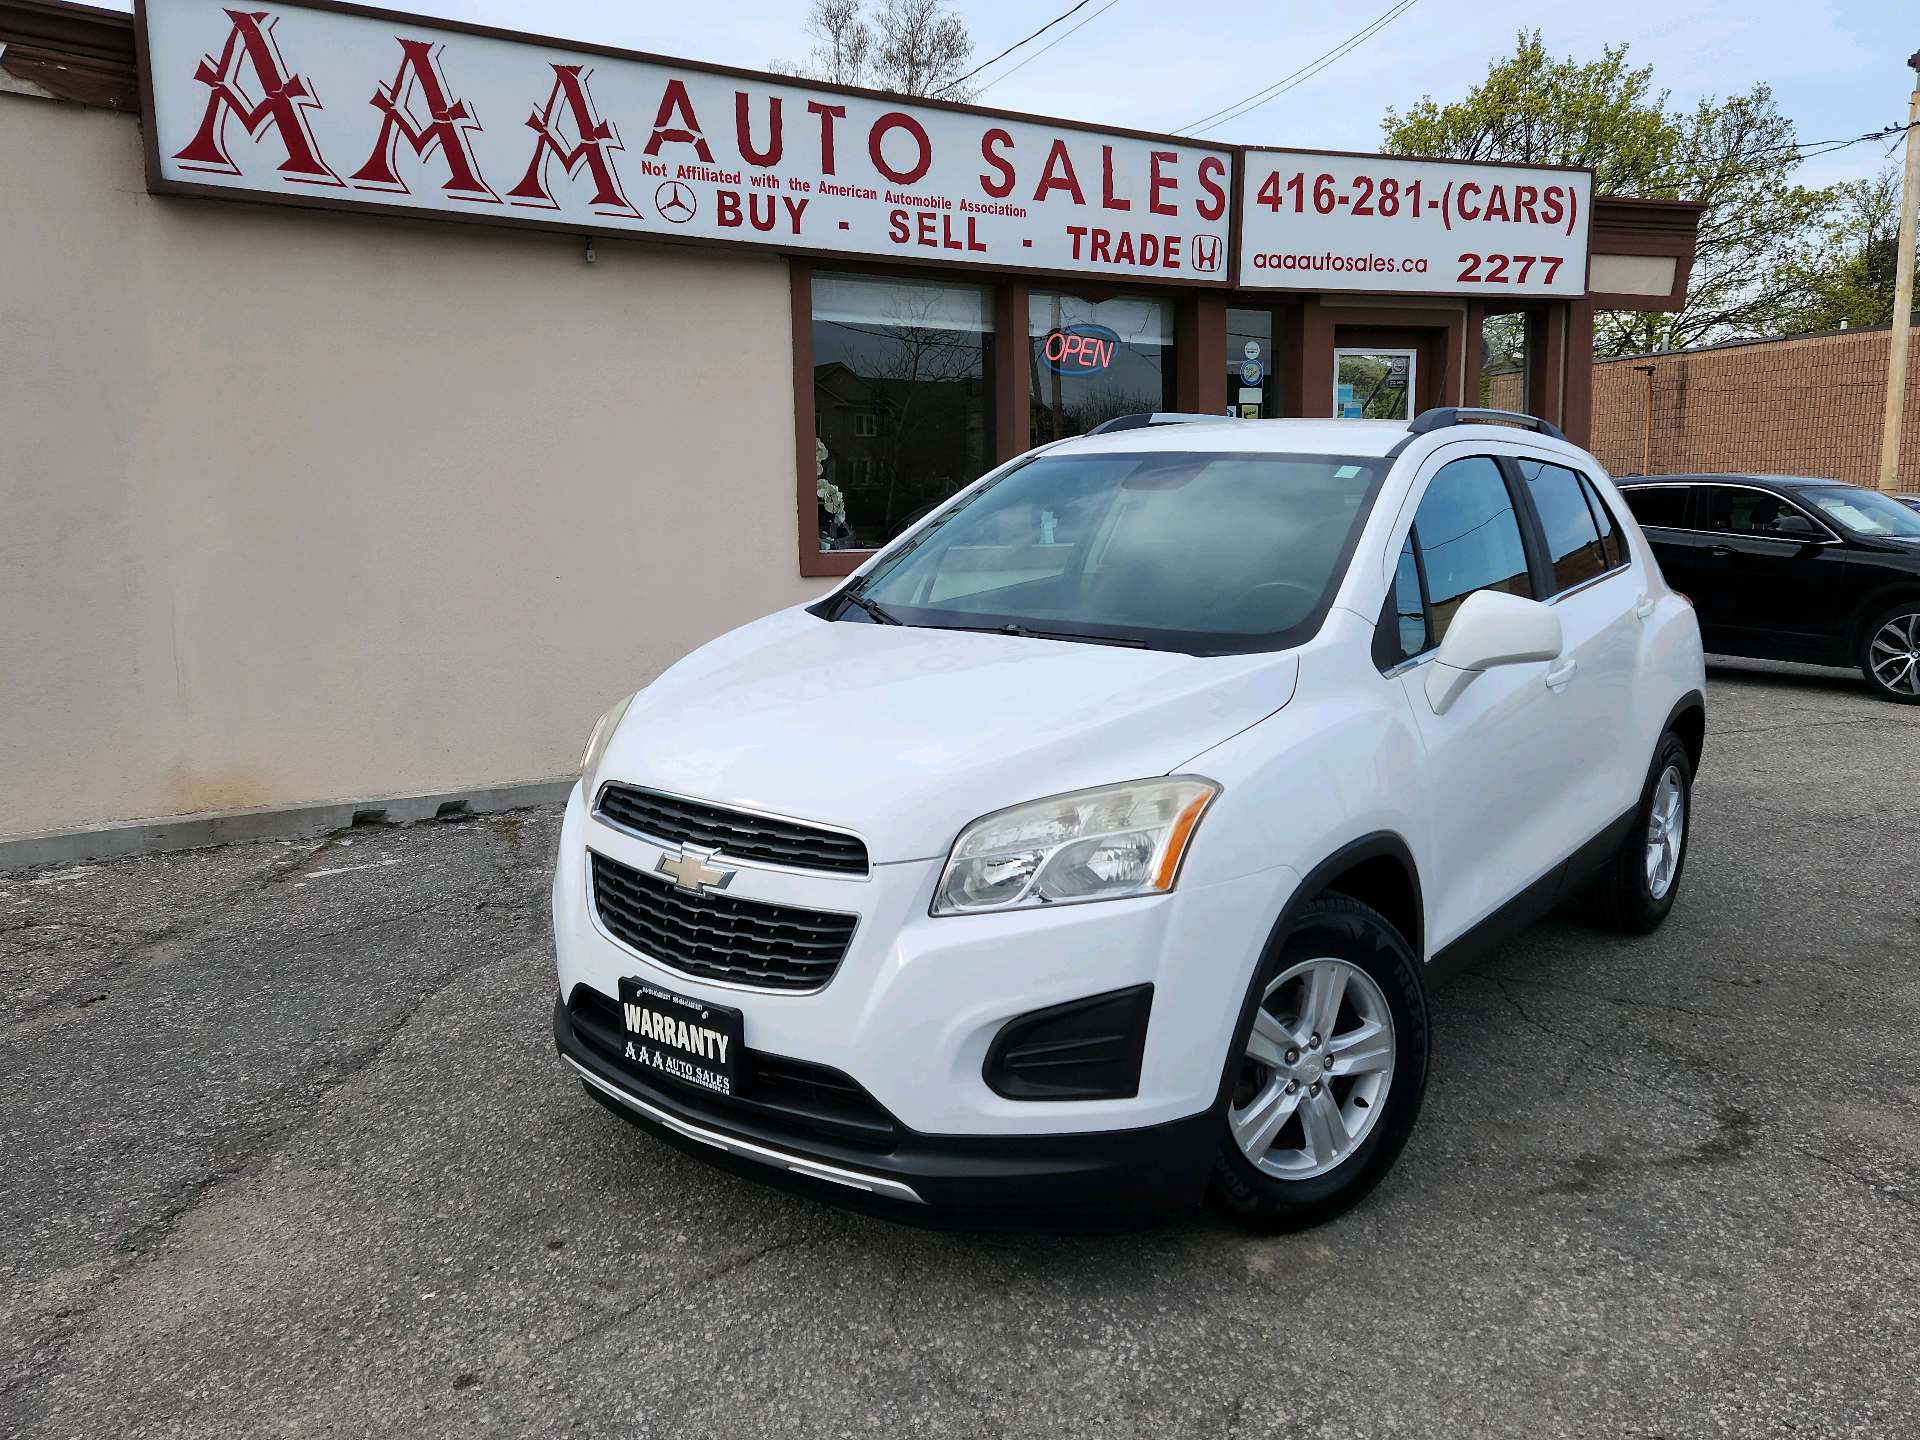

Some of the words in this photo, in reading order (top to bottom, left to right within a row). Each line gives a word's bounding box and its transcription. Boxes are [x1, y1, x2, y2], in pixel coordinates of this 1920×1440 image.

[643, 78, 932, 185] AUTO
[979, 128, 1226, 221] SALES
[641, 160, 667, 177] Not
[676, 164, 741, 185] Affiliated
[750, 174, 780, 189] with
[788, 177, 810, 192] the
[818, 180, 877, 200] American
[884, 190, 952, 210] Automobile
[959, 198, 1027, 218] Association
[1256, 170, 1577, 237] 416-281-(CARS)
[716, 189, 810, 235] BUY
[888, 209, 987, 253] SELL
[1066, 225, 1182, 270] TRADE
[1253, 251, 1428, 274] aaaautosales.ca
[1456, 253, 1564, 285] 2277
[1045, 332, 1114, 368] OPEN
[623, 1002, 729, 1064] WARRANTY
[666, 1056, 693, 1076] AUTO
[695, 1067, 730, 1090] SALES
